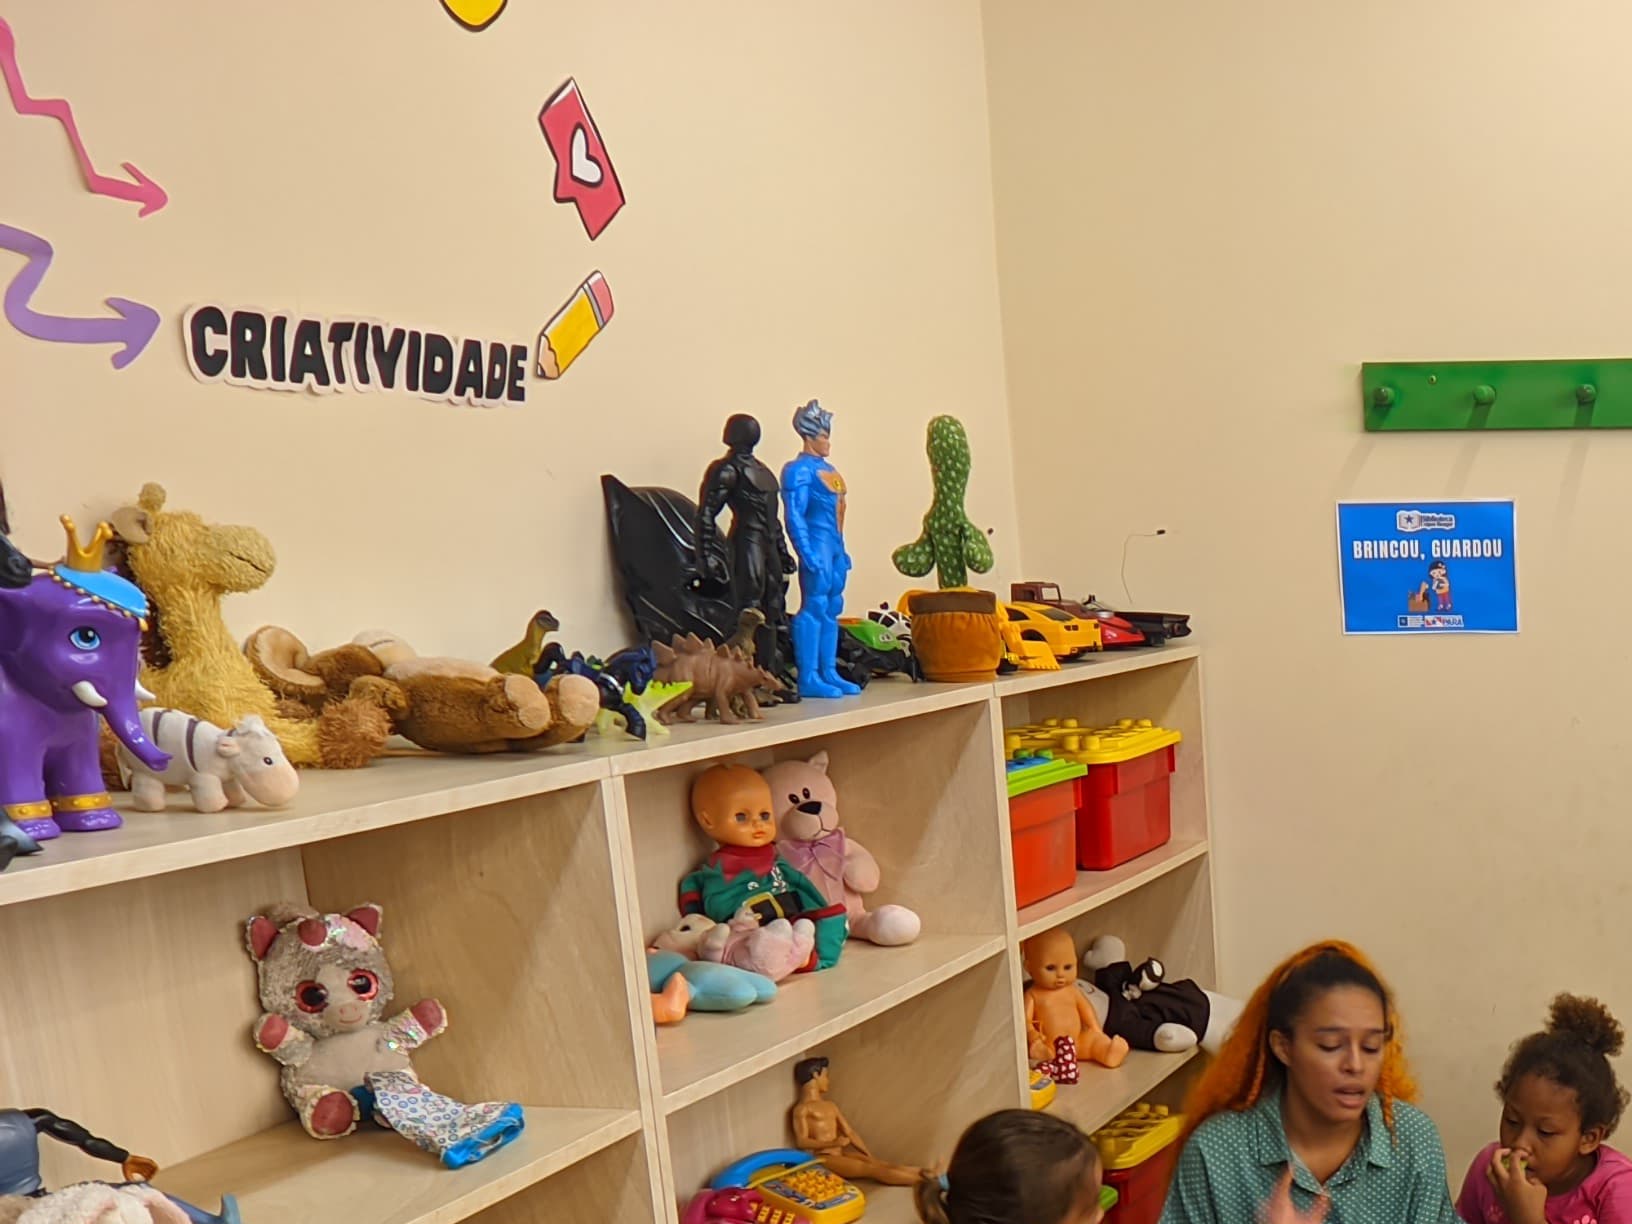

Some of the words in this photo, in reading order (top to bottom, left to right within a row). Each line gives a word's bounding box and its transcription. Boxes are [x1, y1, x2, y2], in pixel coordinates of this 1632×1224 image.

[190, 304, 529, 403] CRIATIVIDADE
[1352, 539, 1425, 561] BRINCOU,
[1431, 538, 1503, 558] GUARDOU
